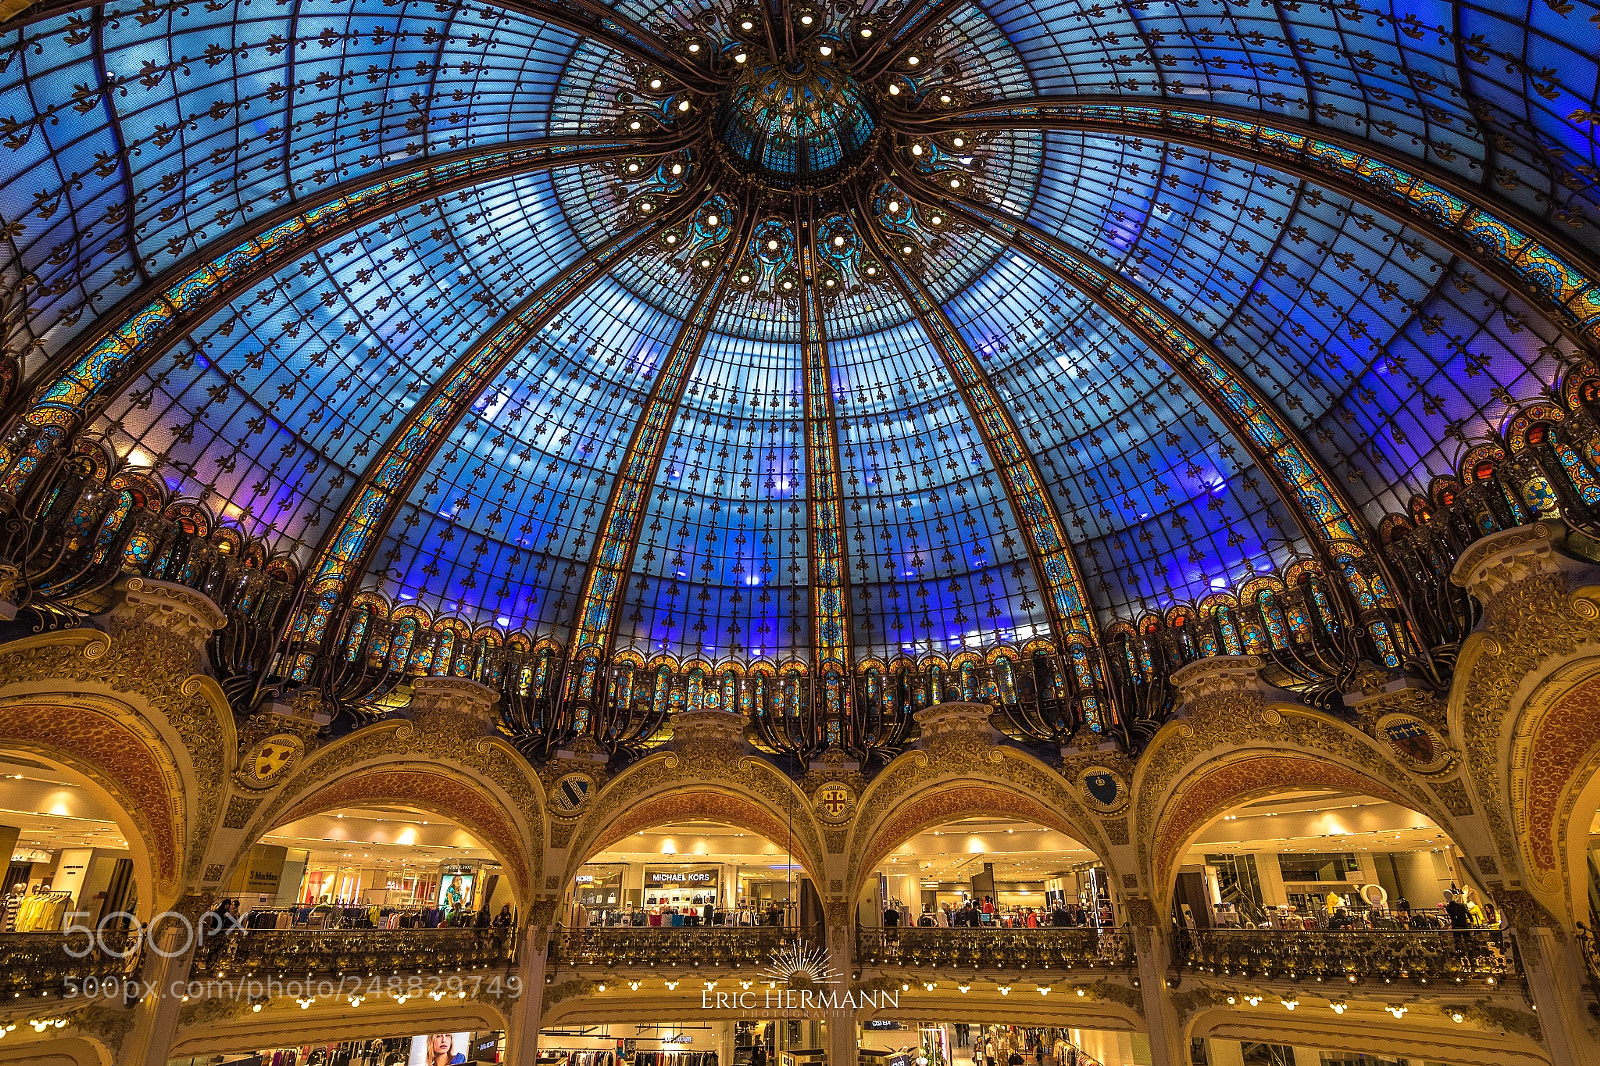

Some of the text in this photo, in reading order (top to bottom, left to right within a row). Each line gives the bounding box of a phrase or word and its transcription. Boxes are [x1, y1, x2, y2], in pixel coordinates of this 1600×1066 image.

[575, 874, 593, 883] KORS
[652, 873, 710, 882] MICHAEL KORS
